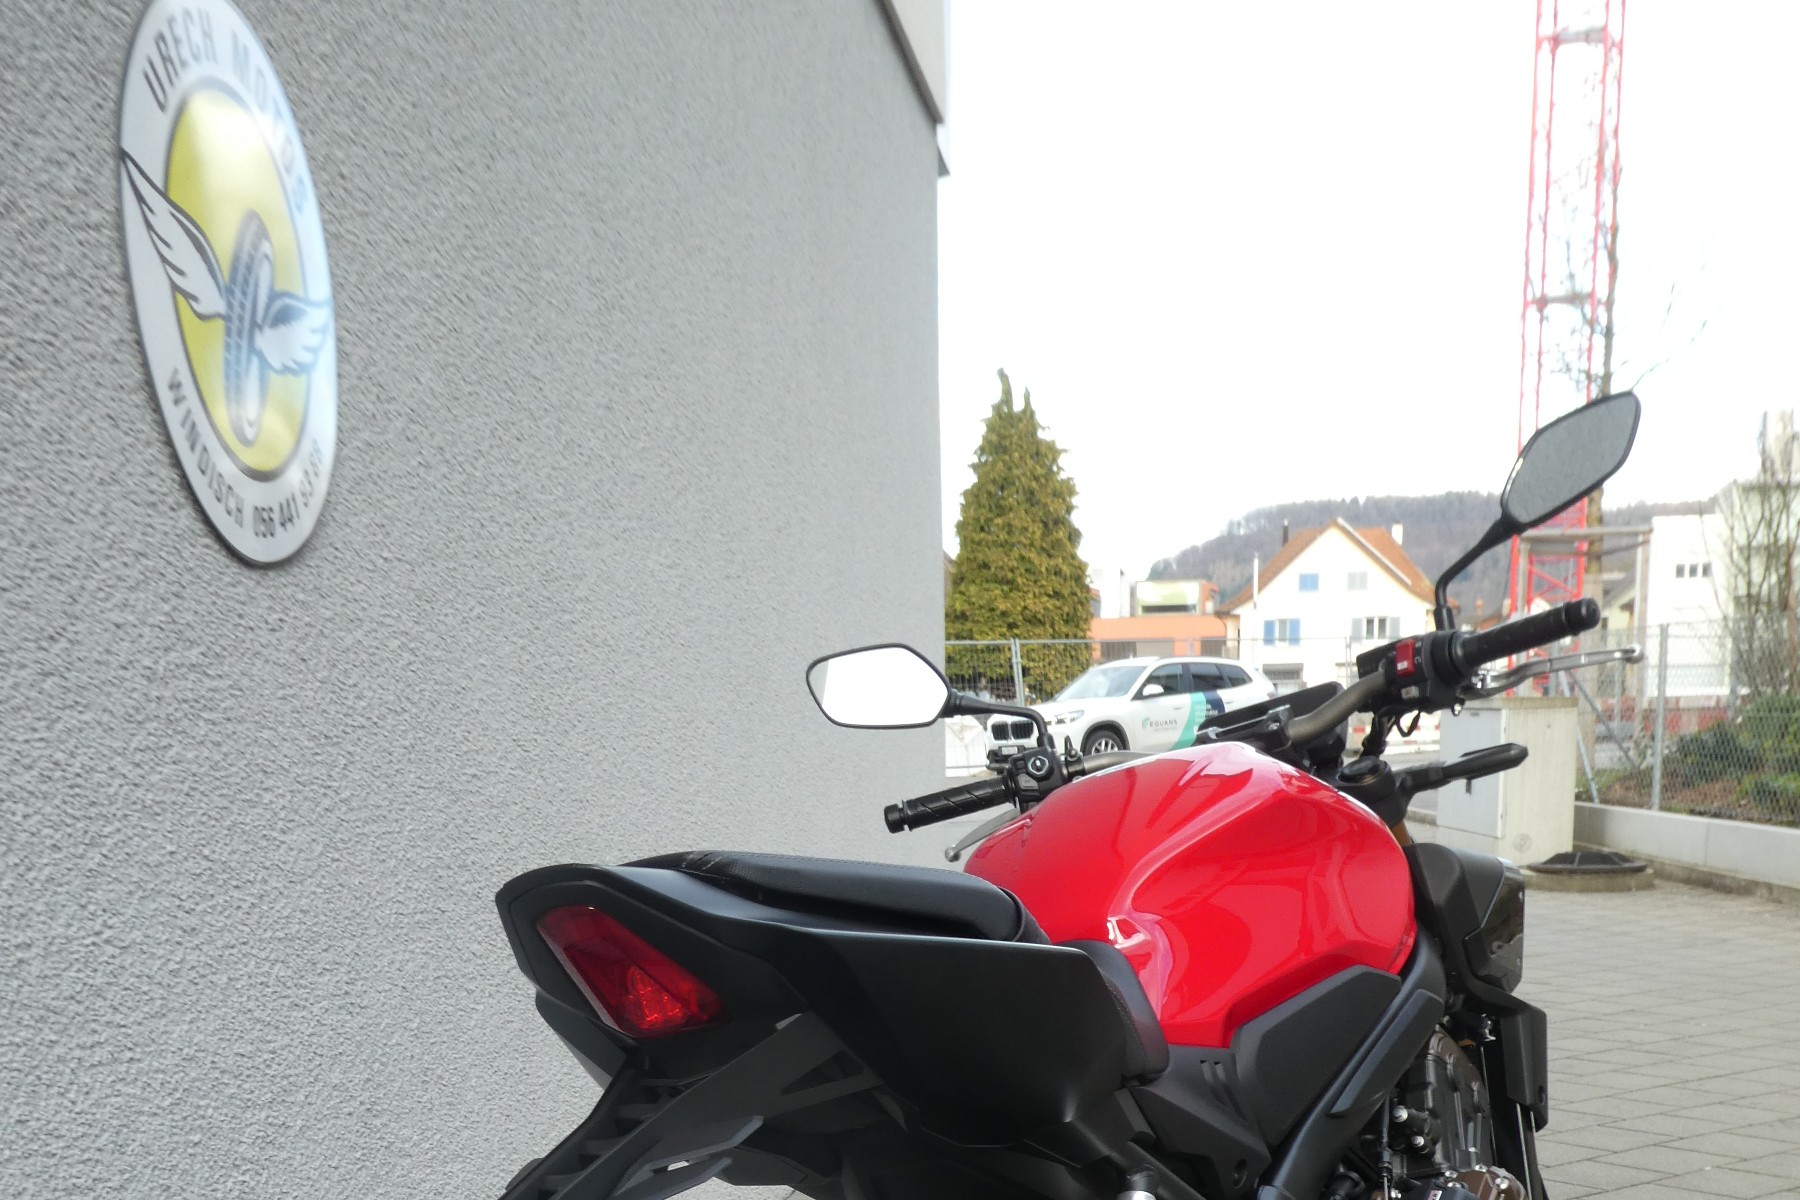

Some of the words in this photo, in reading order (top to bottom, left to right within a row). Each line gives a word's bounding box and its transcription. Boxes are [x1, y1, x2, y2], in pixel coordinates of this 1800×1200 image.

[142, 7, 218, 114] URECH
[168, 367, 245, 528] WINDISCH
[253, 504, 276, 539] 056
[277, 491, 300, 532] 441
